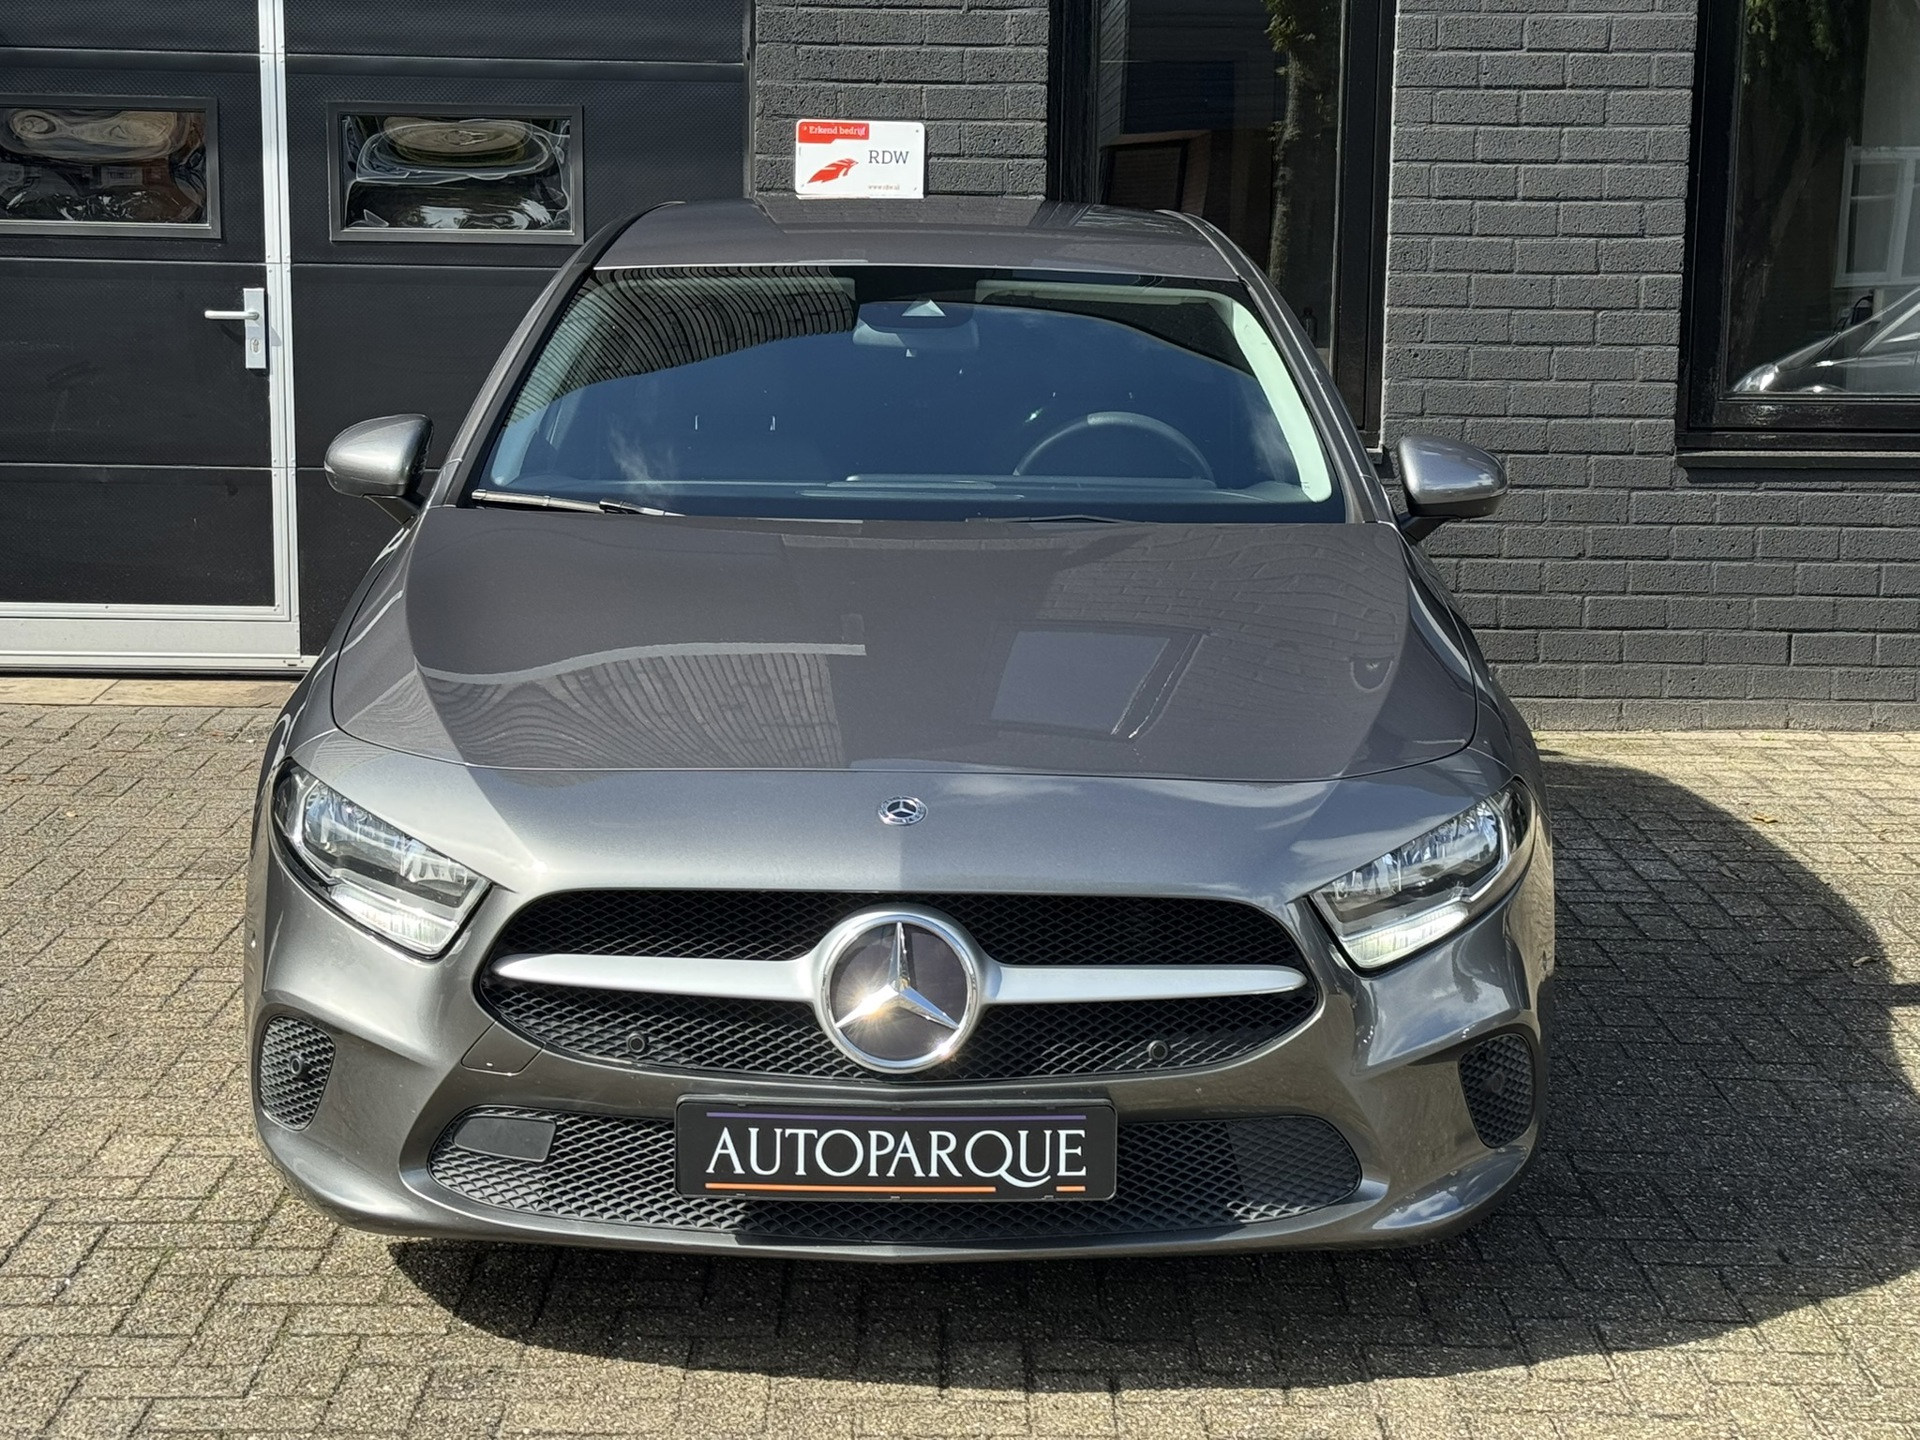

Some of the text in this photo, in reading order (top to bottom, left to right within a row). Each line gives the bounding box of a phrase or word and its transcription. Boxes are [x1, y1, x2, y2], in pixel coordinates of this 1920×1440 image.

[809, 126, 866, 136] Erkend bedrijf
[868, 150, 910, 164] RDW
[705, 1126, 1087, 1188] AUTOPARQUE
